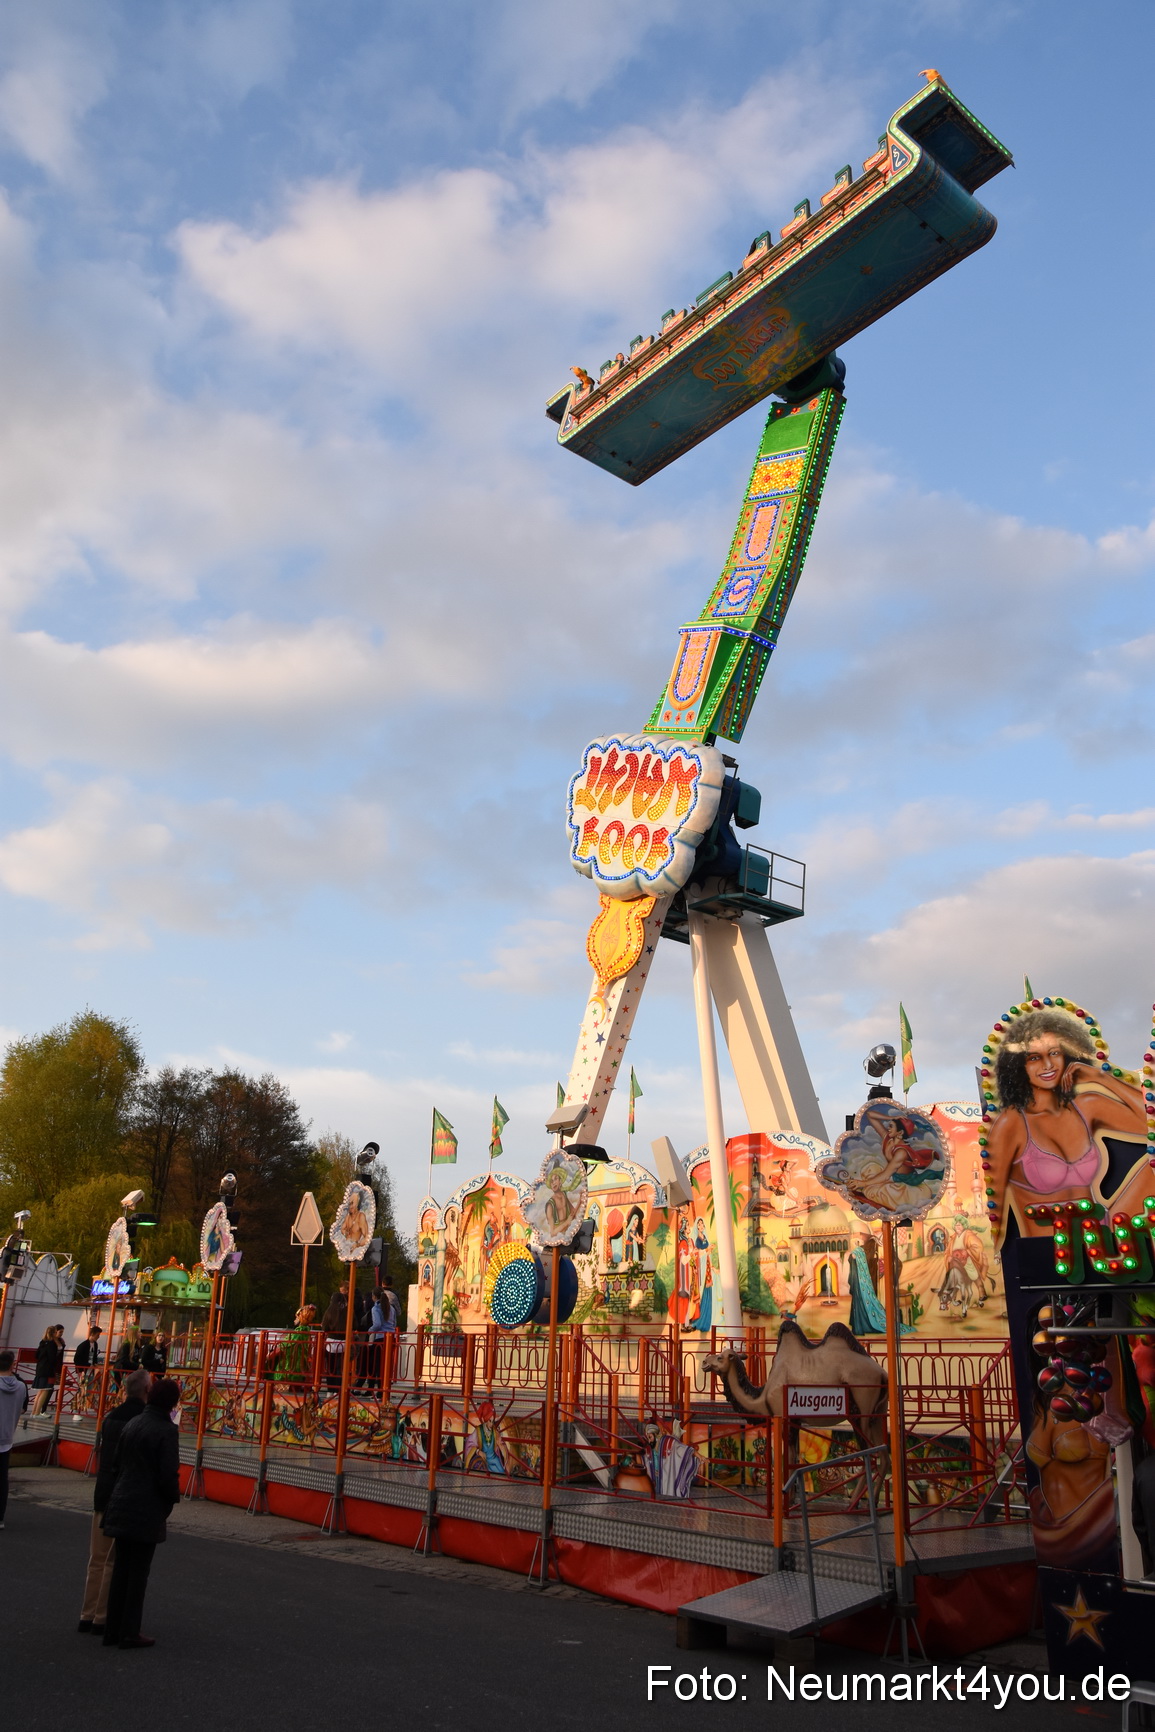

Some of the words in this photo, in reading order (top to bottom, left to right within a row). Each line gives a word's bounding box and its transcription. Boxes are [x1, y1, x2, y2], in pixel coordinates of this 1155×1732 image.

[704, 356, 744, 385] 1001
[735, 316, 790, 360] NACHT
[789, 1391, 844, 1412] Ausgang
